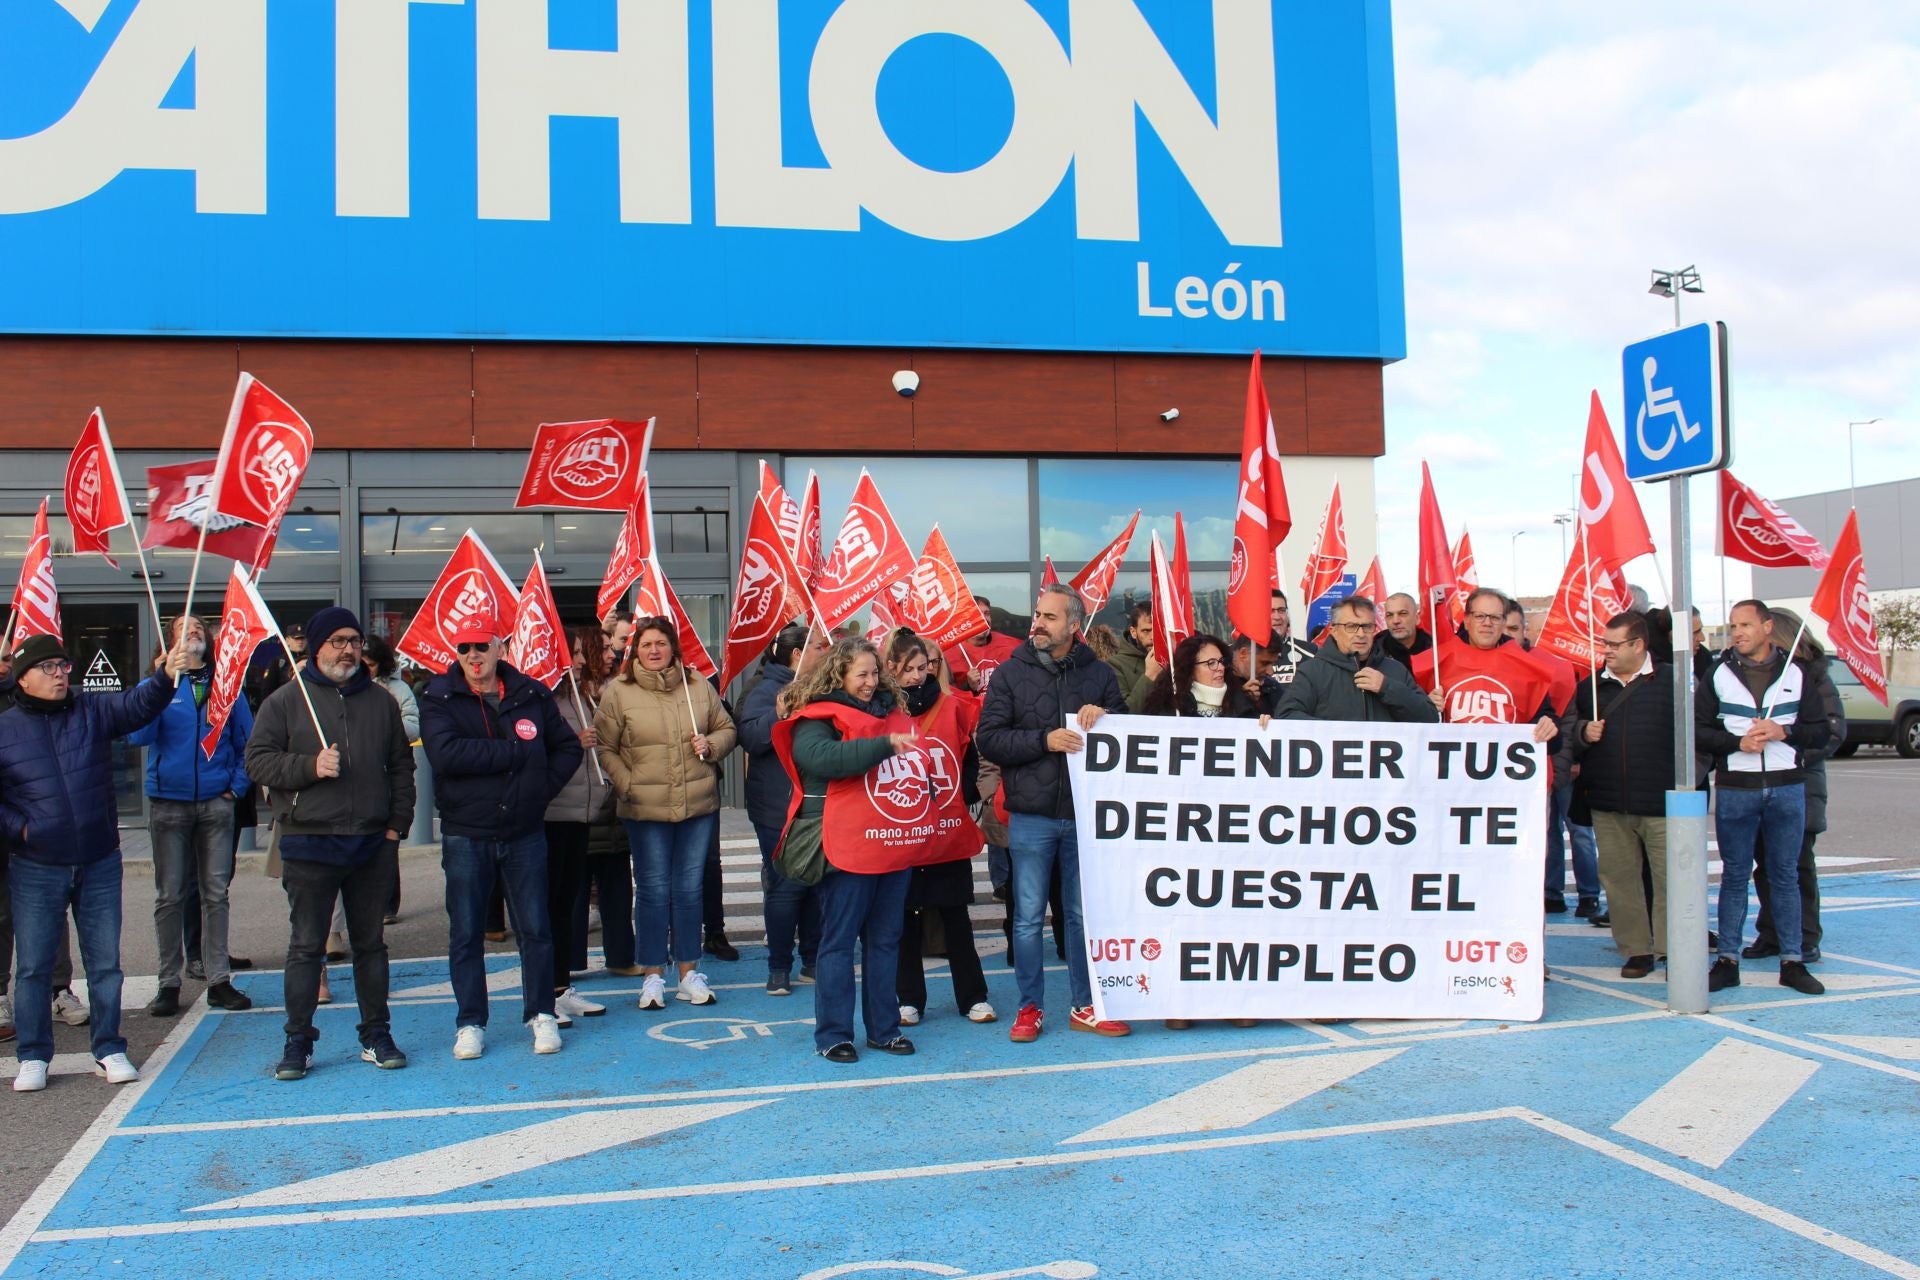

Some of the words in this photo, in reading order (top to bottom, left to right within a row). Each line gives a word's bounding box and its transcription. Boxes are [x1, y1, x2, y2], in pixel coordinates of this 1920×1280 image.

[1137, 261, 1285, 321] León
[563, 437, 619, 467] UGT
[838, 509, 879, 571] UGT
[831, 562, 899, 618] www.ugt.es
[911, 562, 952, 620] UGT
[935, 620, 973, 645] .ugt.es
[83, 677, 121, 686] SALIDA
[1450, 689, 1508, 717] UGT
[878, 750, 927, 782] UGT
[1086, 733, 1404, 779] DEFENDER
[1428, 741, 1536, 780] TUS
[865, 828, 902, 839] mano
[911, 824, 934, 836] man
[1096, 801, 1417, 845] DERECHOS
[1450, 807, 1517, 845] TE
[1145, 867, 1378, 911] CUESTA
[1411, 873, 1475, 911] EL
[1090, 938, 1136, 962] UGT
[1180, 942, 1416, 982] EMPLEO
[1446, 940, 1501, 963] UGT
[1454, 975, 1497, 987] FeSMC
